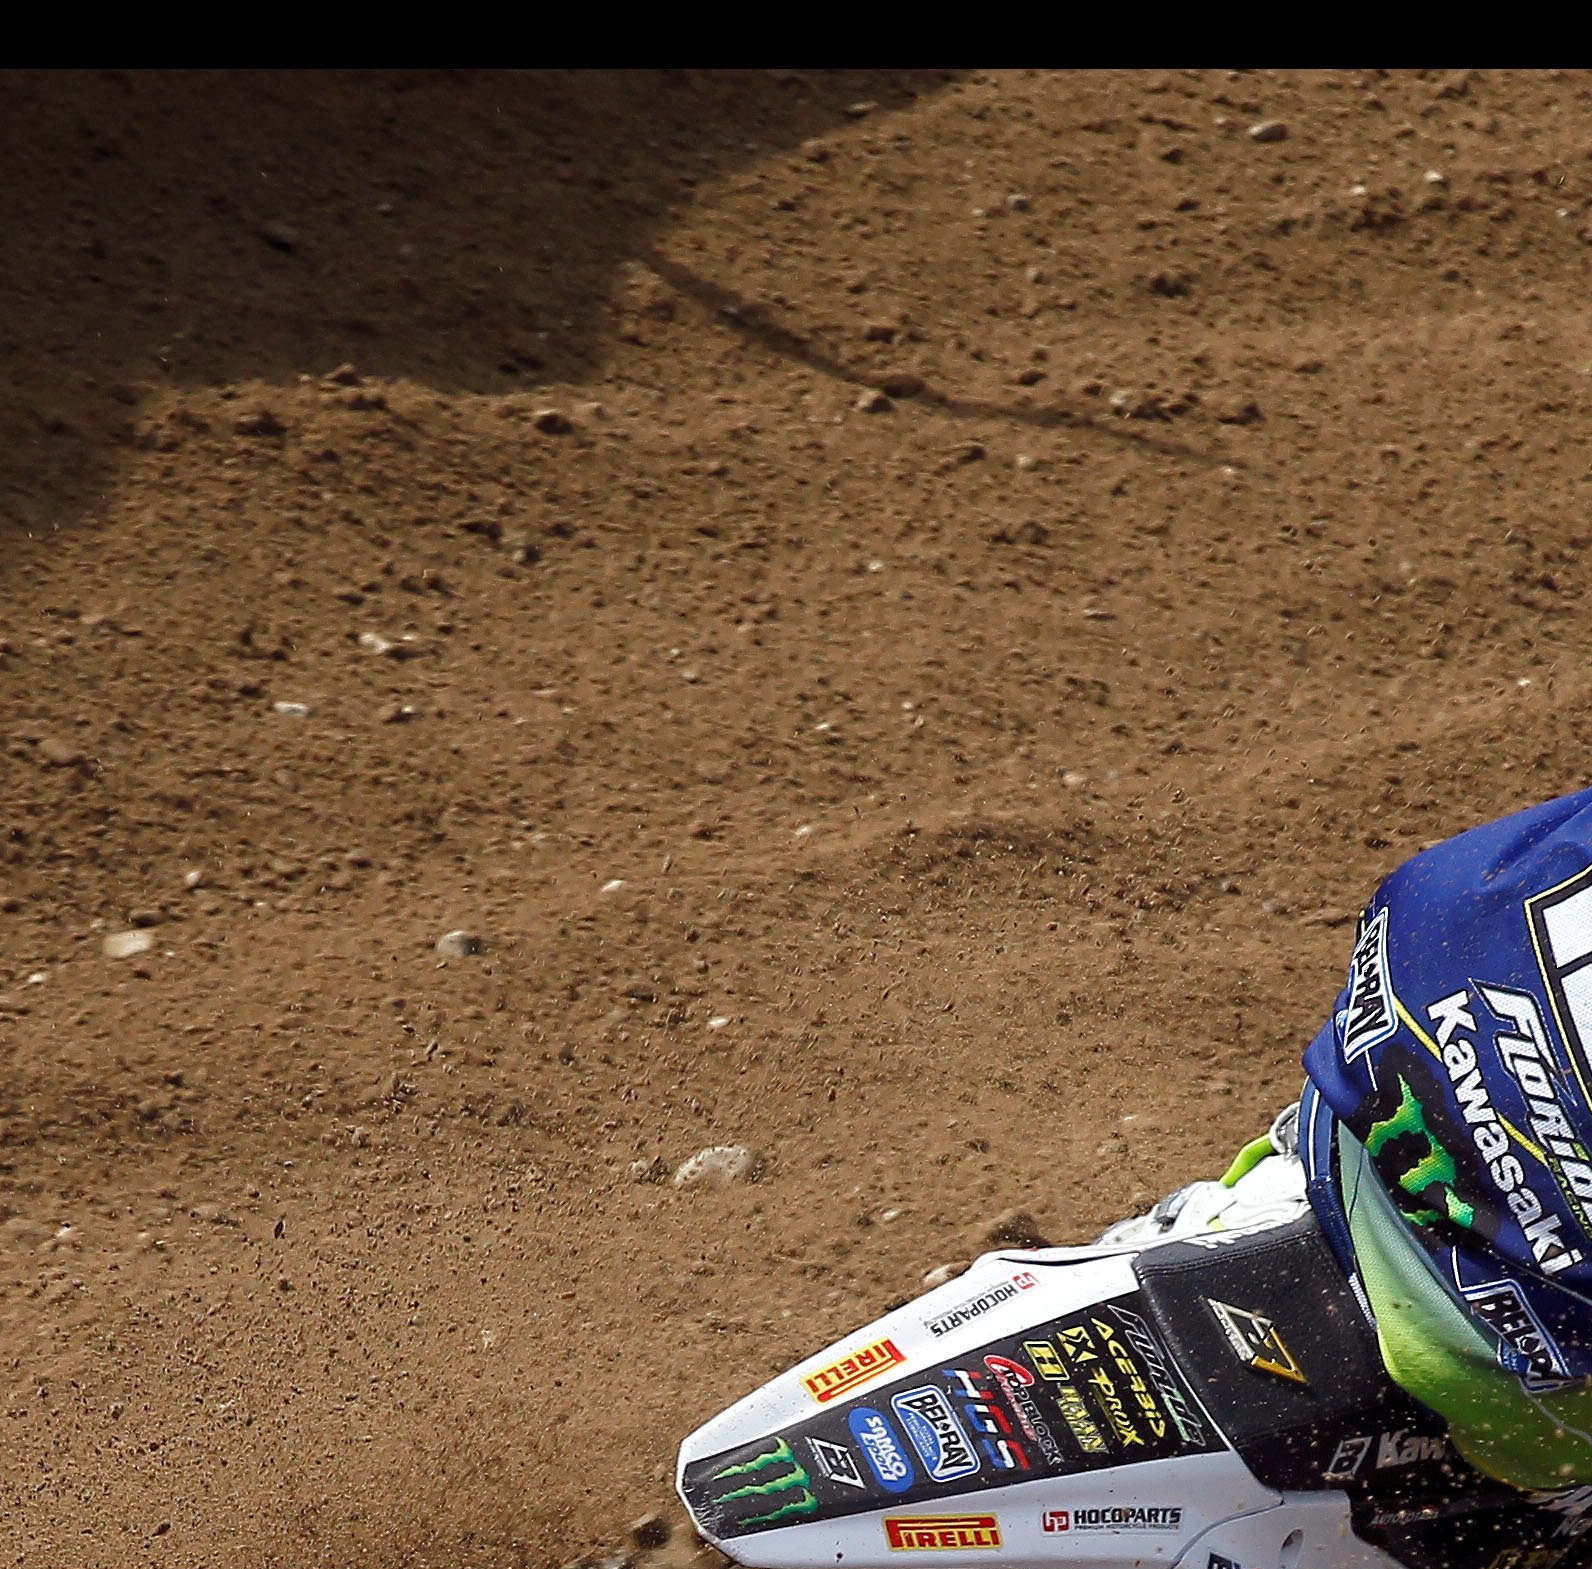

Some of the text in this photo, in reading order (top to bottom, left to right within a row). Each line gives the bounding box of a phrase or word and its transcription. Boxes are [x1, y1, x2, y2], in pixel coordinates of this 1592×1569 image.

[1427, 991, 1583, 1276] Kawasaki
[929, 1283, 1020, 1338] HOCOPARTS
[804, 1338, 907, 1403] PIRELLI
[865, 1414, 908, 1480] SAMCO
[885, 1515, 1000, 1549] PIRELLI
[1074, 1507, 1182, 1526] HOCOPARTS
